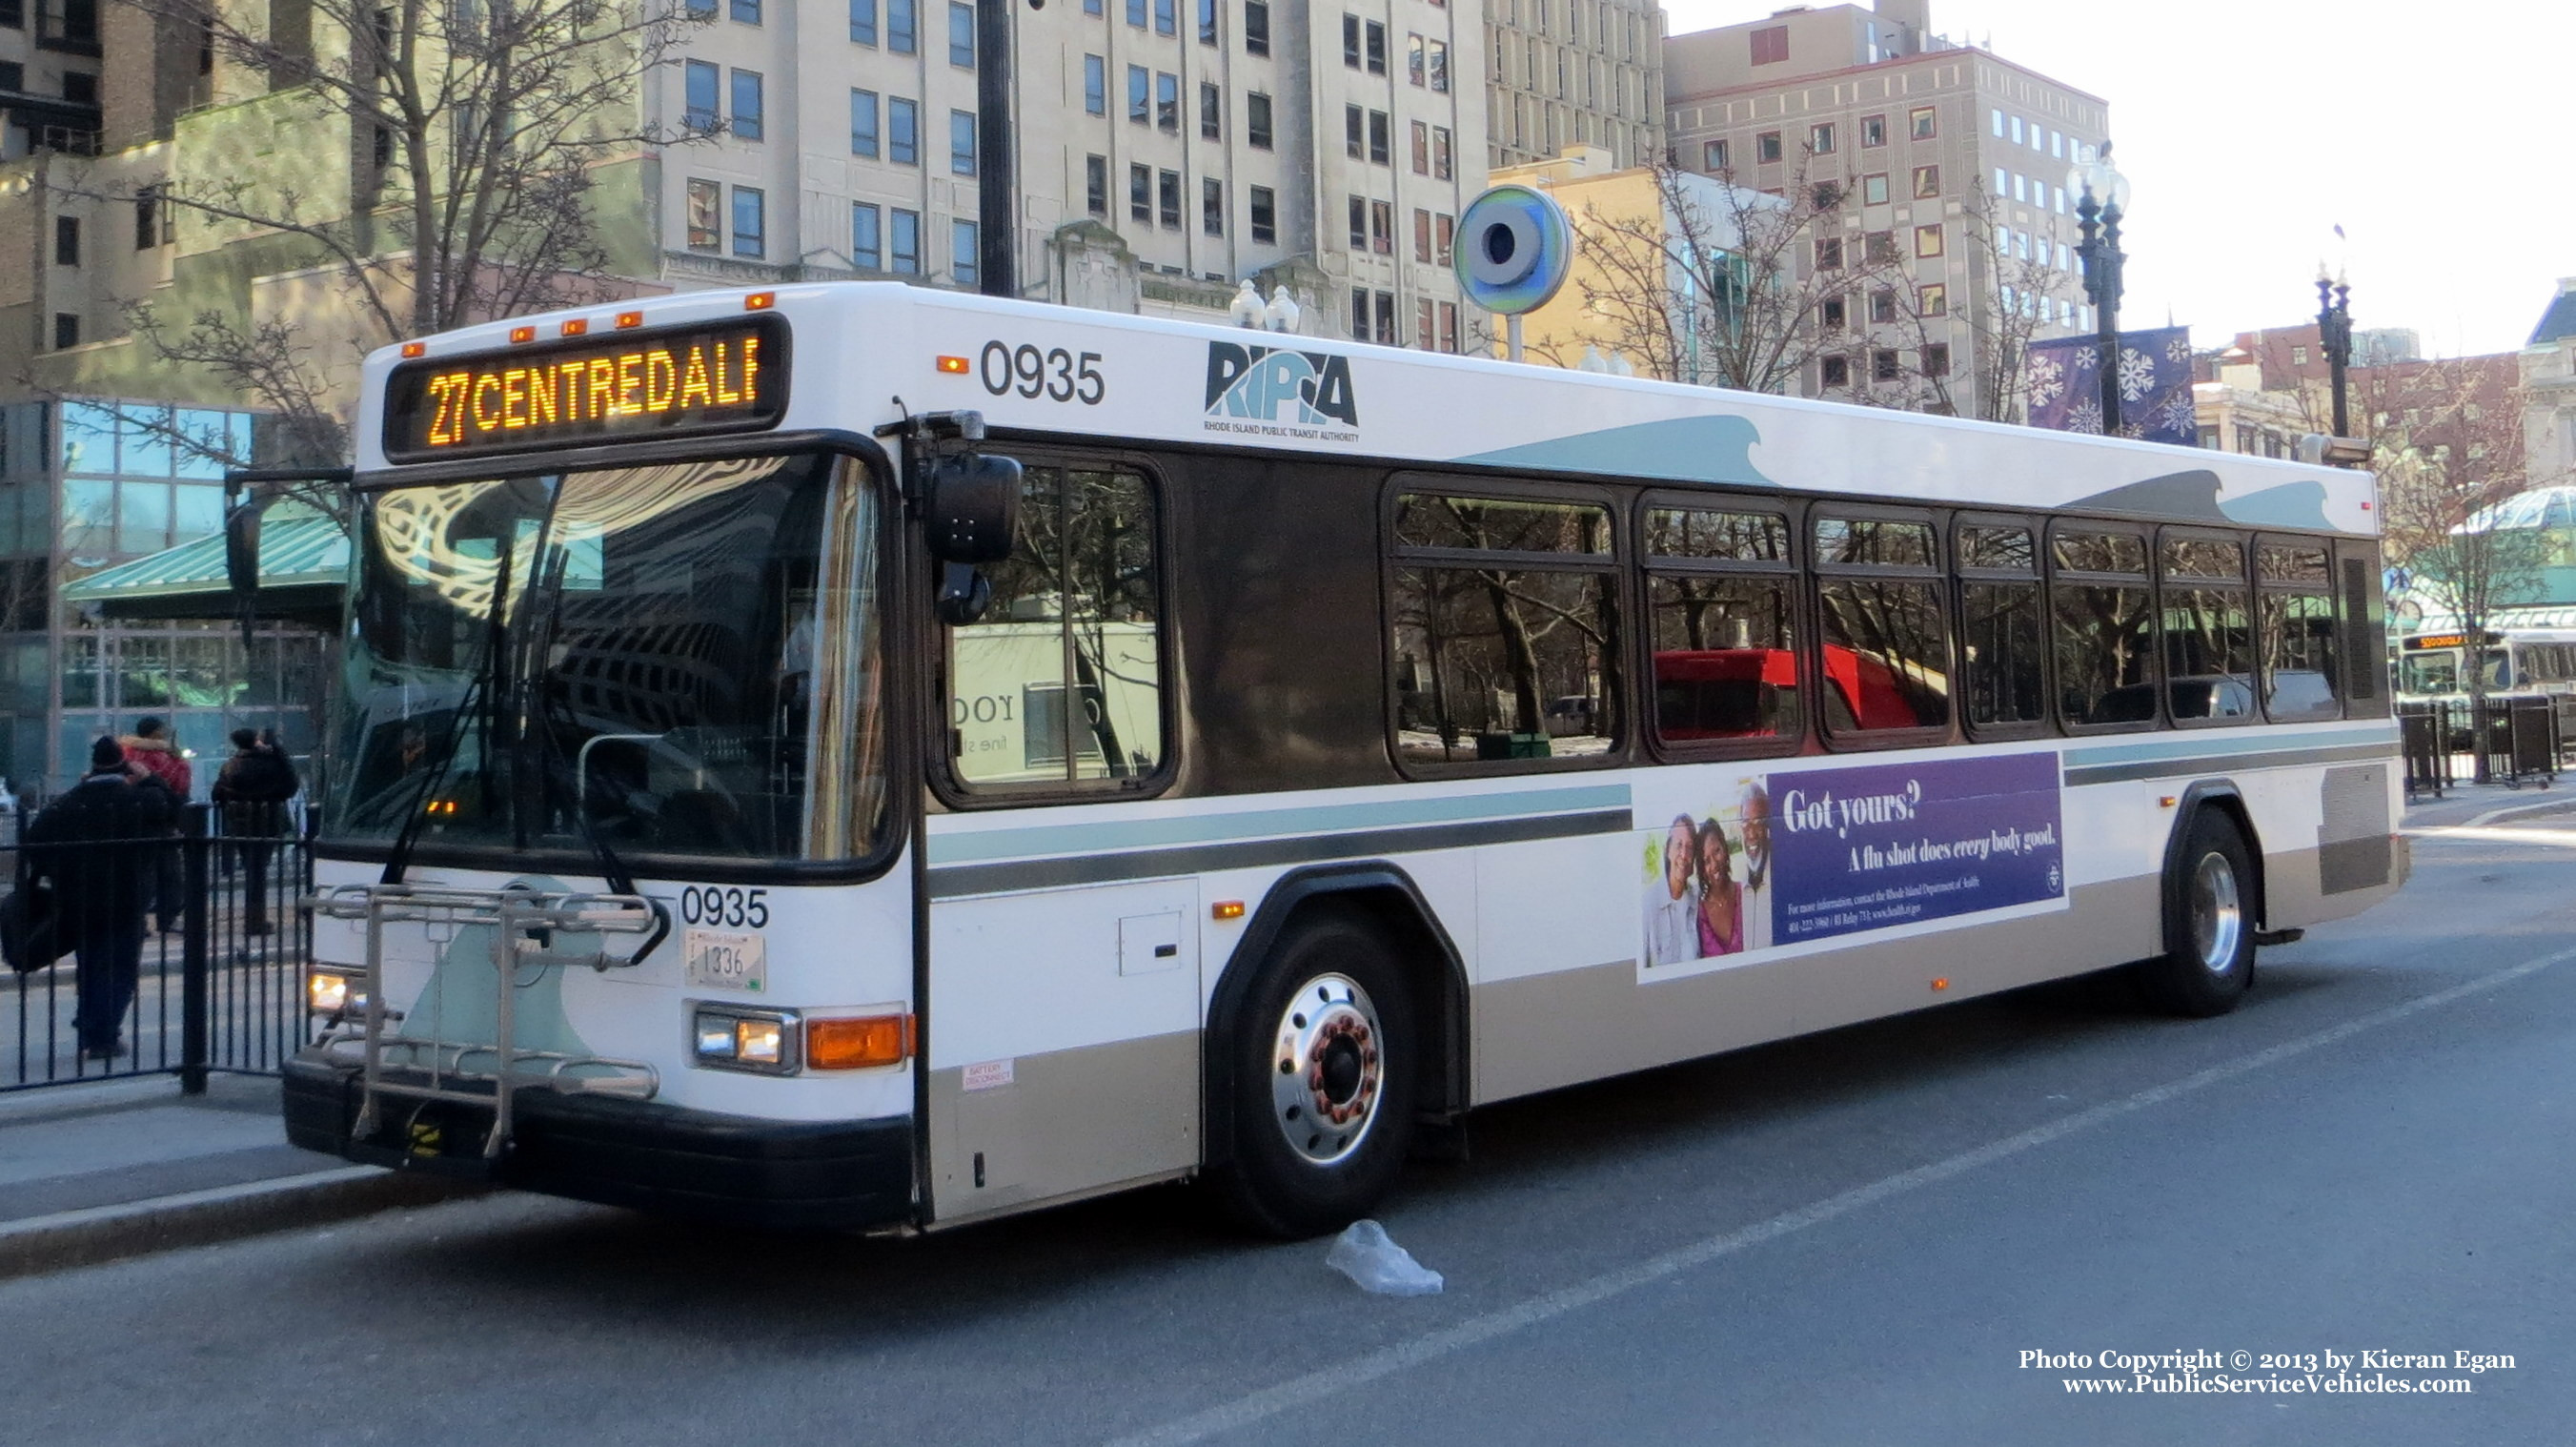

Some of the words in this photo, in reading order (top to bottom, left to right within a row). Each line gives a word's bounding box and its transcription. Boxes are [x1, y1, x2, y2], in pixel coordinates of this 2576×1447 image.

[981, 339, 1105, 406] 0935
[1205, 340, 1359, 428] RIPTA
[1204, 420, 1231, 432] RHODE
[1232, 424, 1260, 435] ISLAND
[1262, 426, 1288, 438] PUBLIC
[1288, 429, 1318, 439] TRANSIT
[1320, 432, 1359, 443] AUTHORITY
[1783, 789, 1834, 832] Got
[1838, 779, 1921, 839] yours?
[1848, 846, 1860, 872] A
[1863, 845, 1884, 870] flu
[1886, 842, 1917, 866] shot
[1919, 838, 1951, 862] does
[1953, 837, 1990, 860] every
[1992, 829, 2021, 856] body
[2023, 823, 2056, 851] good.
[681, 886, 769, 928] 0935
[1788, 903, 1799, 915] For
[1886, 887, 1904, 900] Rhode
[704, 946, 743, 975] 1336
